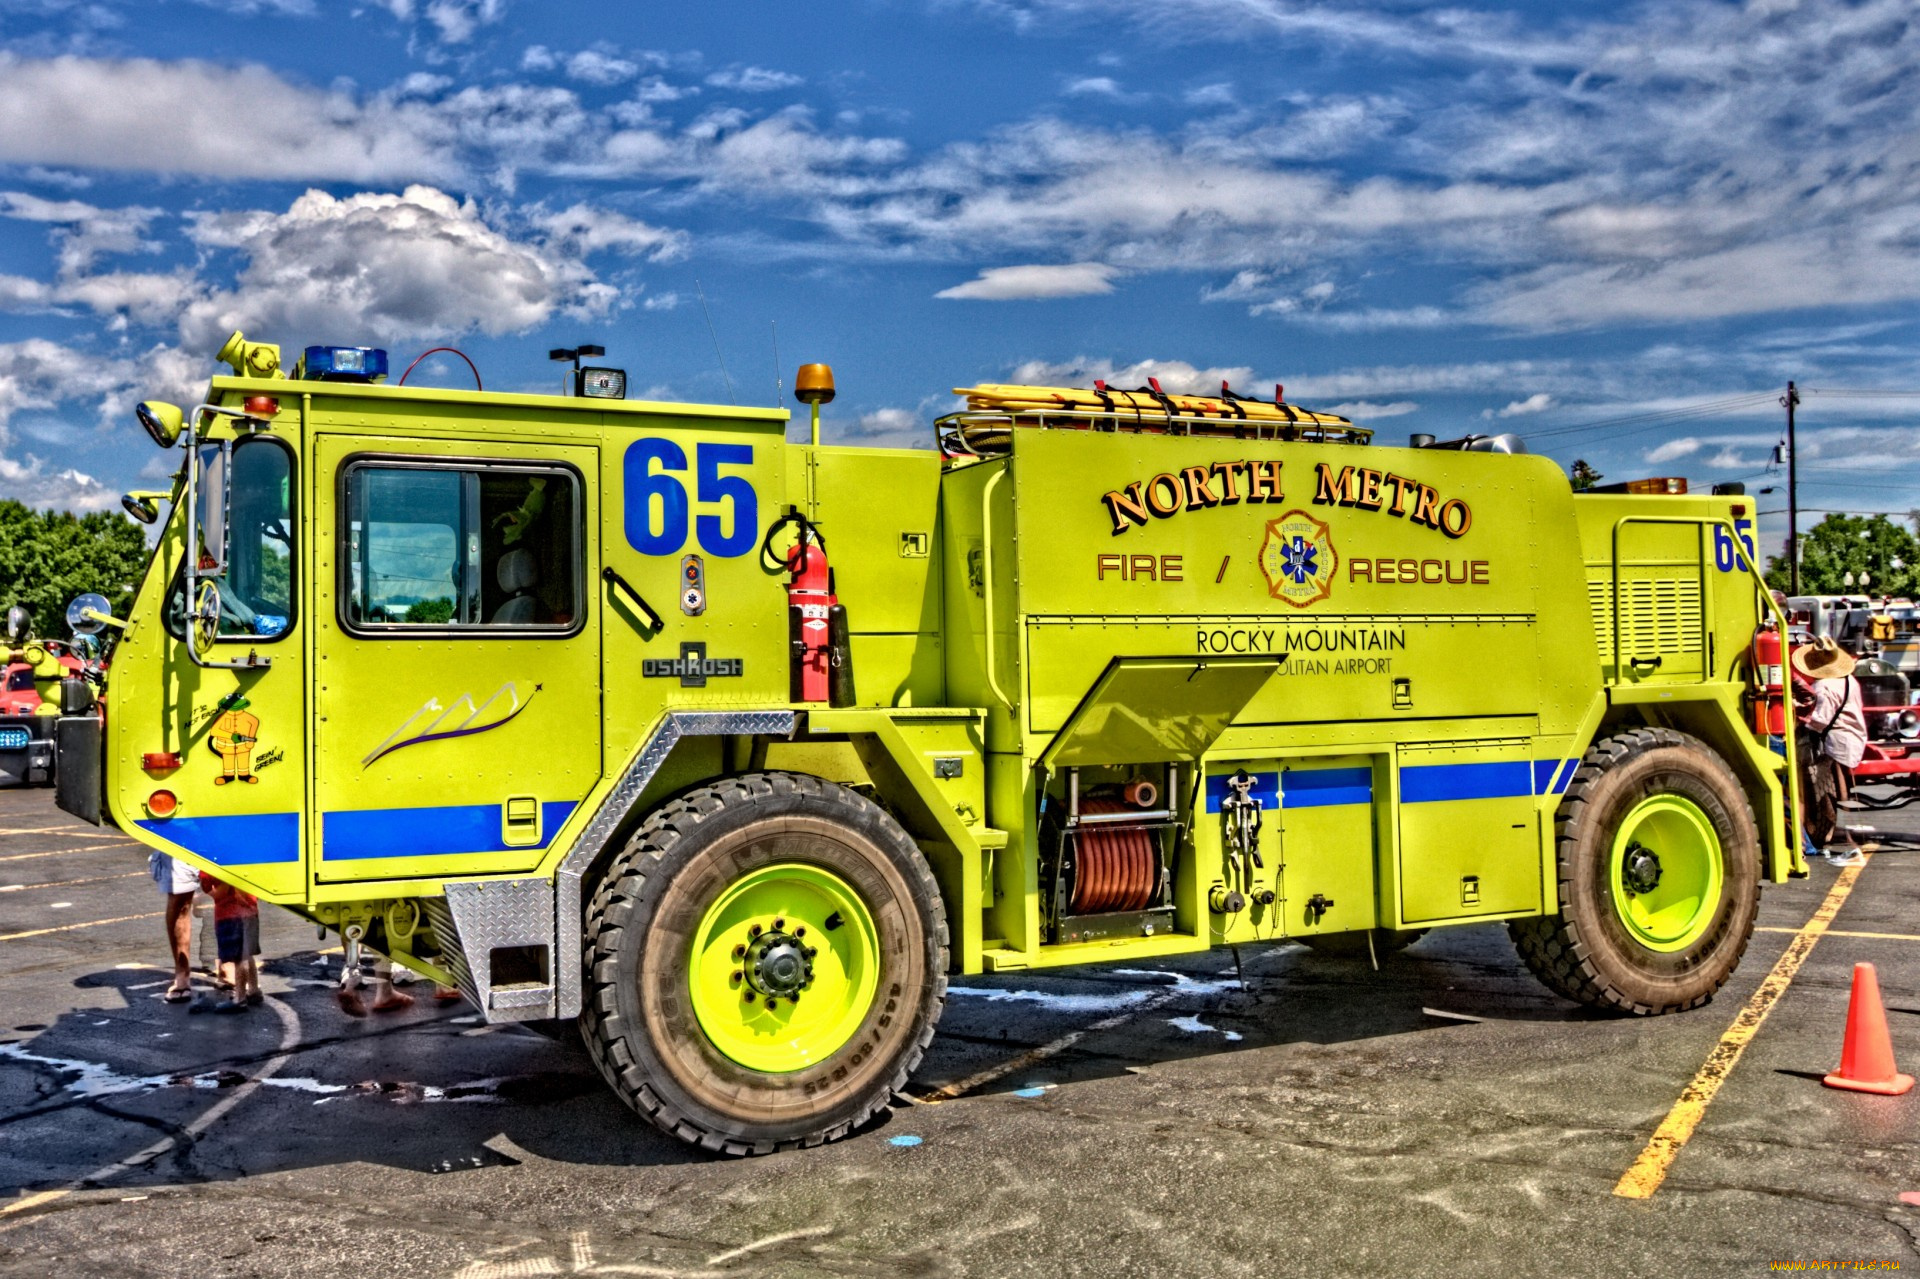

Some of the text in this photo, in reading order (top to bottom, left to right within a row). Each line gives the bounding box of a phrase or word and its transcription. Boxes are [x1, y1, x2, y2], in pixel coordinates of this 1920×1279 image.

[623, 437, 758, 558] 65
[1101, 459, 1472, 539] NORTH METRO
[1281, 523, 1313, 533] NORTH
[1269, 543, 1277, 575] FIRE
[1318, 537, 1329, 581] RESCUE
[1713, 519, 1755, 573] 65
[1097, 554, 1183, 581] FIRE
[1215, 555, 1231, 583] /
[1349, 558, 1490, 584] RESCUE
[1282, 585, 1317, 597] METRO
[1196, 629, 1406, 653] ROCKY MOUNTAIN
[643, 659, 743, 676] OSHKOSH
[1276, 658, 1393, 676] OLITAN AIRPORT
[254, 750, 284, 772] GREEN!
[1666, 774, 1734, 838] MICHELIN
[772, 838, 890, 907] MICHELIN
[849, 983, 900, 1067] 445/80
[804, 1076, 829, 1096] 25
[832, 1065, 848, 1080] R
